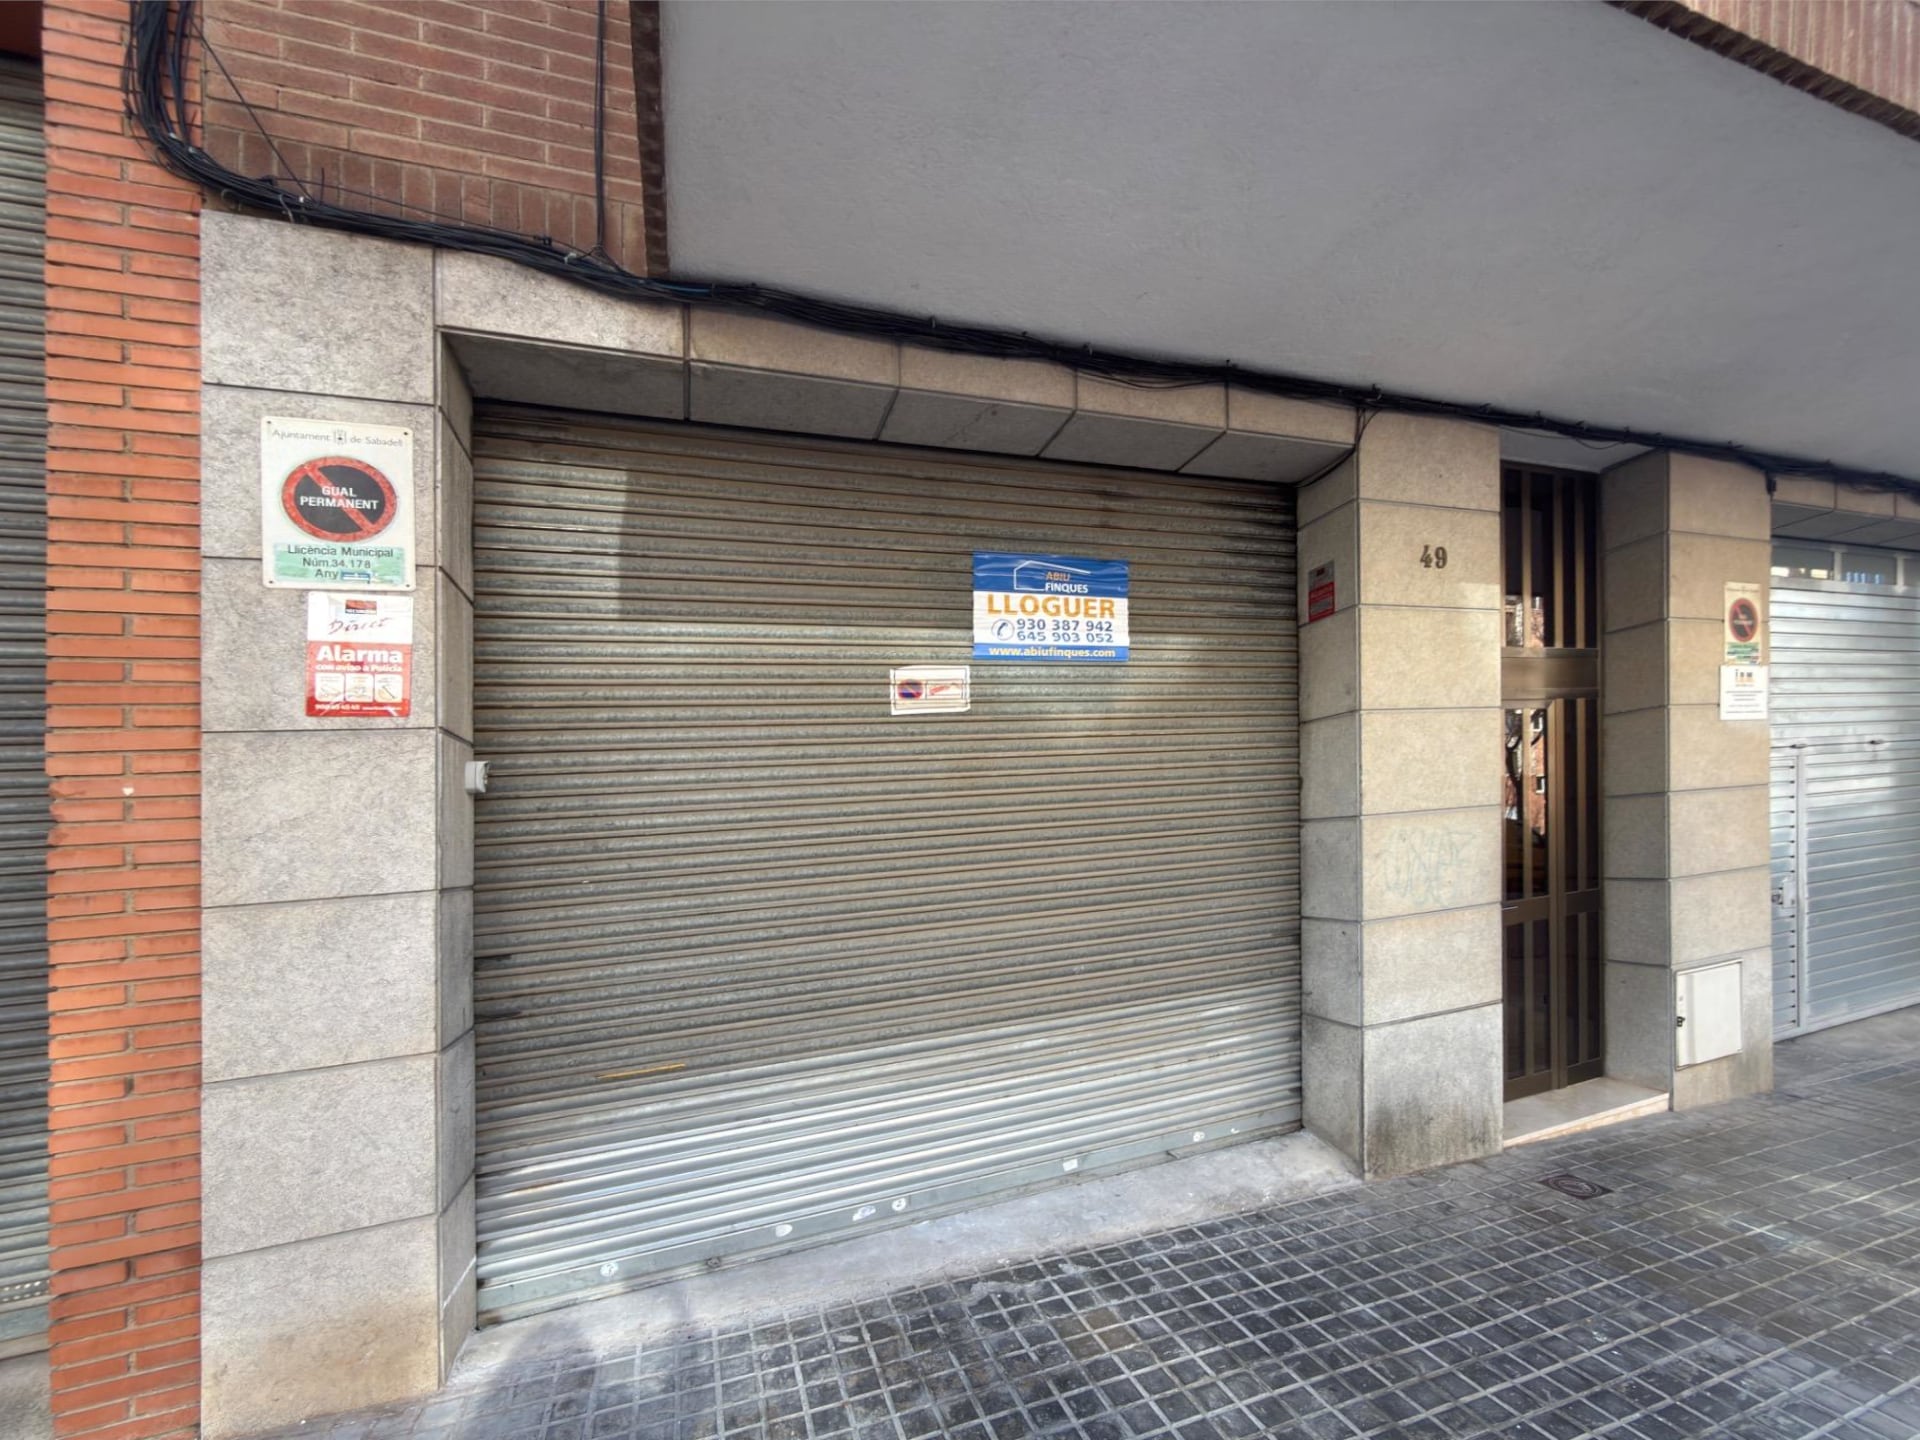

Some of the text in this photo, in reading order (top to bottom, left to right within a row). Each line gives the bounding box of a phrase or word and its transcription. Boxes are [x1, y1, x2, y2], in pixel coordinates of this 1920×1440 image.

[272, 429, 403, 447] Ajuntament de Sabadell
[321, 486, 357, 497] GUAL
[300, 496, 379, 510] PERMANENT
[287, 544, 394, 558] Llicència Municipal
[1420, 545, 1448, 569] 49
[315, 569, 339, 580] Any
[1045, 571, 1071, 582] ABIU
[1045, 583, 1089, 594] FINQUES
[987, 594, 1116, 618] LLOGUER
[1016, 618, 1113, 632] 930 387 942
[1017, 631, 1114, 644] 645 903 052
[317, 645, 403, 663] Alarma
[988, 646, 1116, 659] www.abiufinques.com
